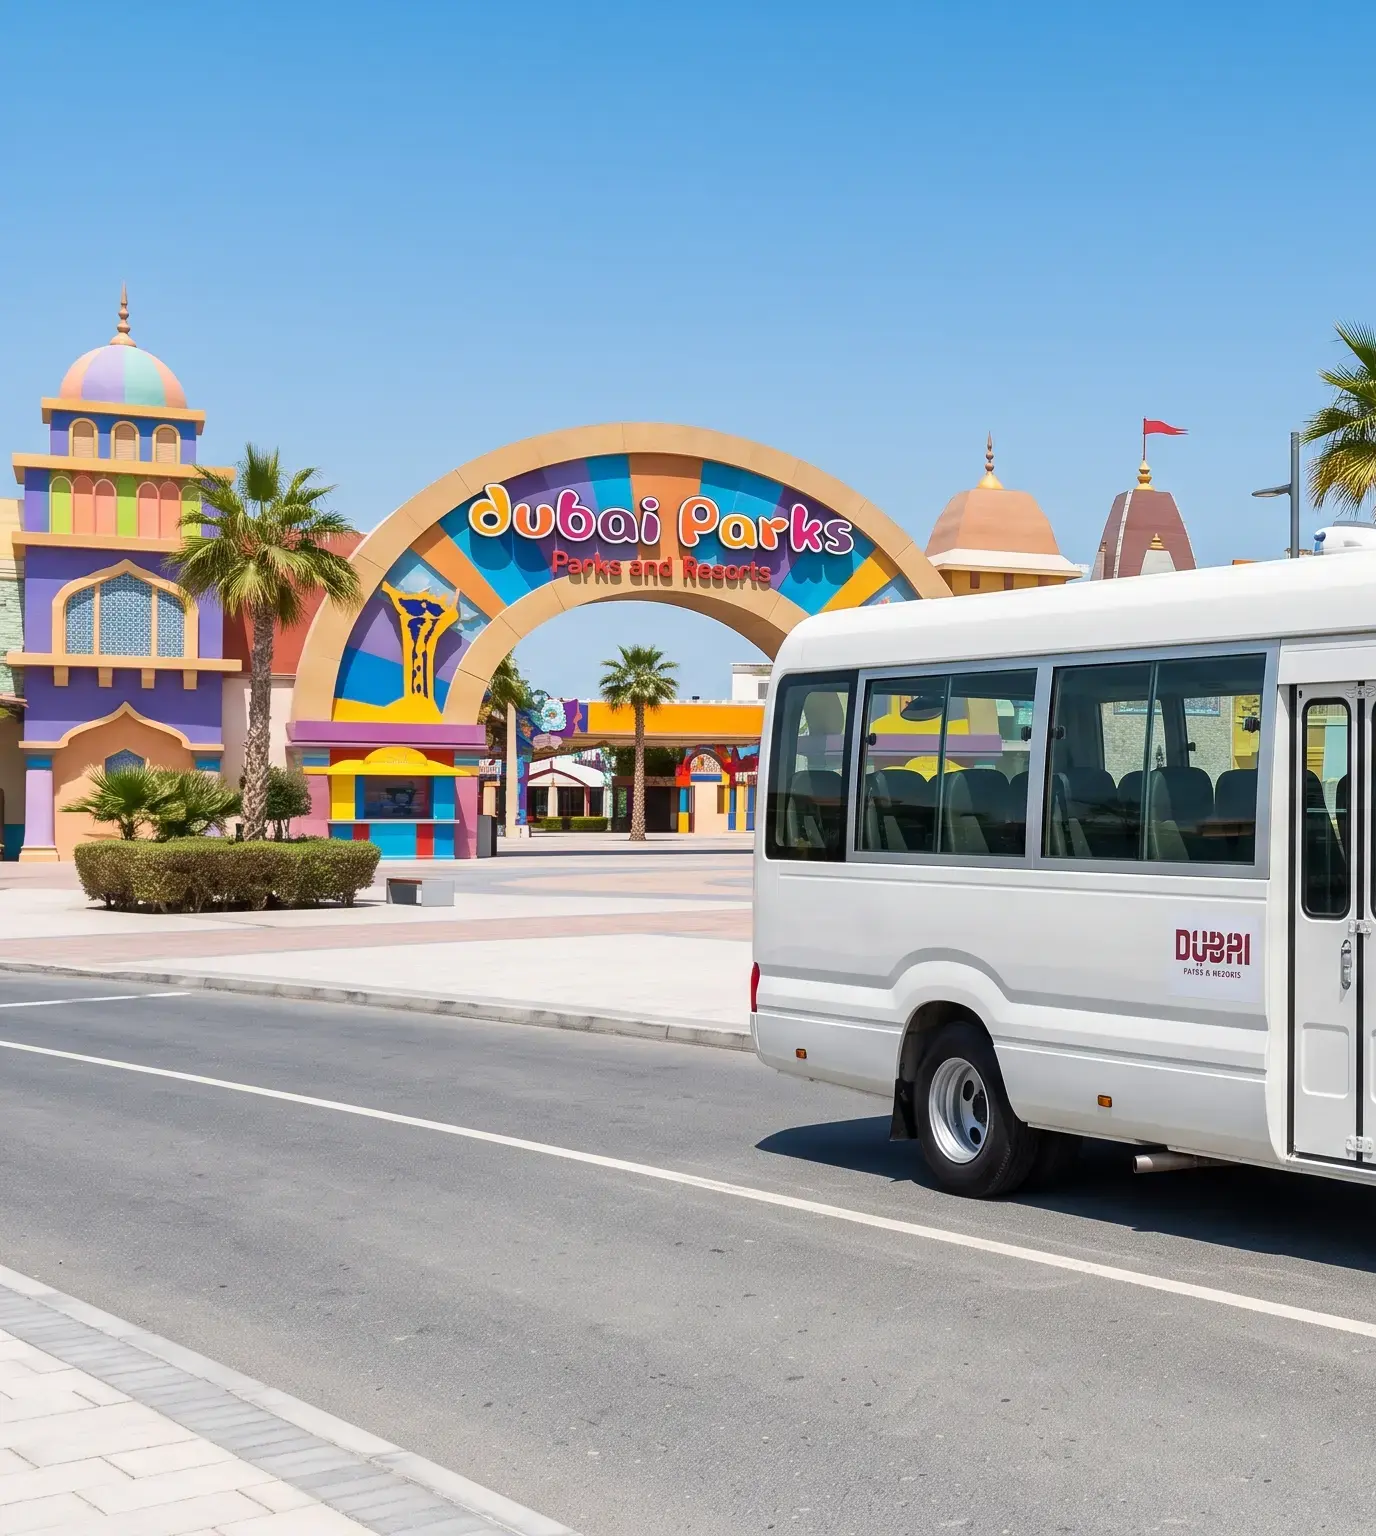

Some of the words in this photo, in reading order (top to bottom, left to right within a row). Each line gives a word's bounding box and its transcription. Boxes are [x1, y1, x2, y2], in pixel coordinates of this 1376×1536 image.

[468, 483, 661, 546] dubai
[678, 496, 855, 554] Parks
[552, 550, 622, 576] Parks
[629, 556, 673, 578] and
[683, 556, 771, 583] Resorts
[1175, 928, 1251, 967] DUBAI
